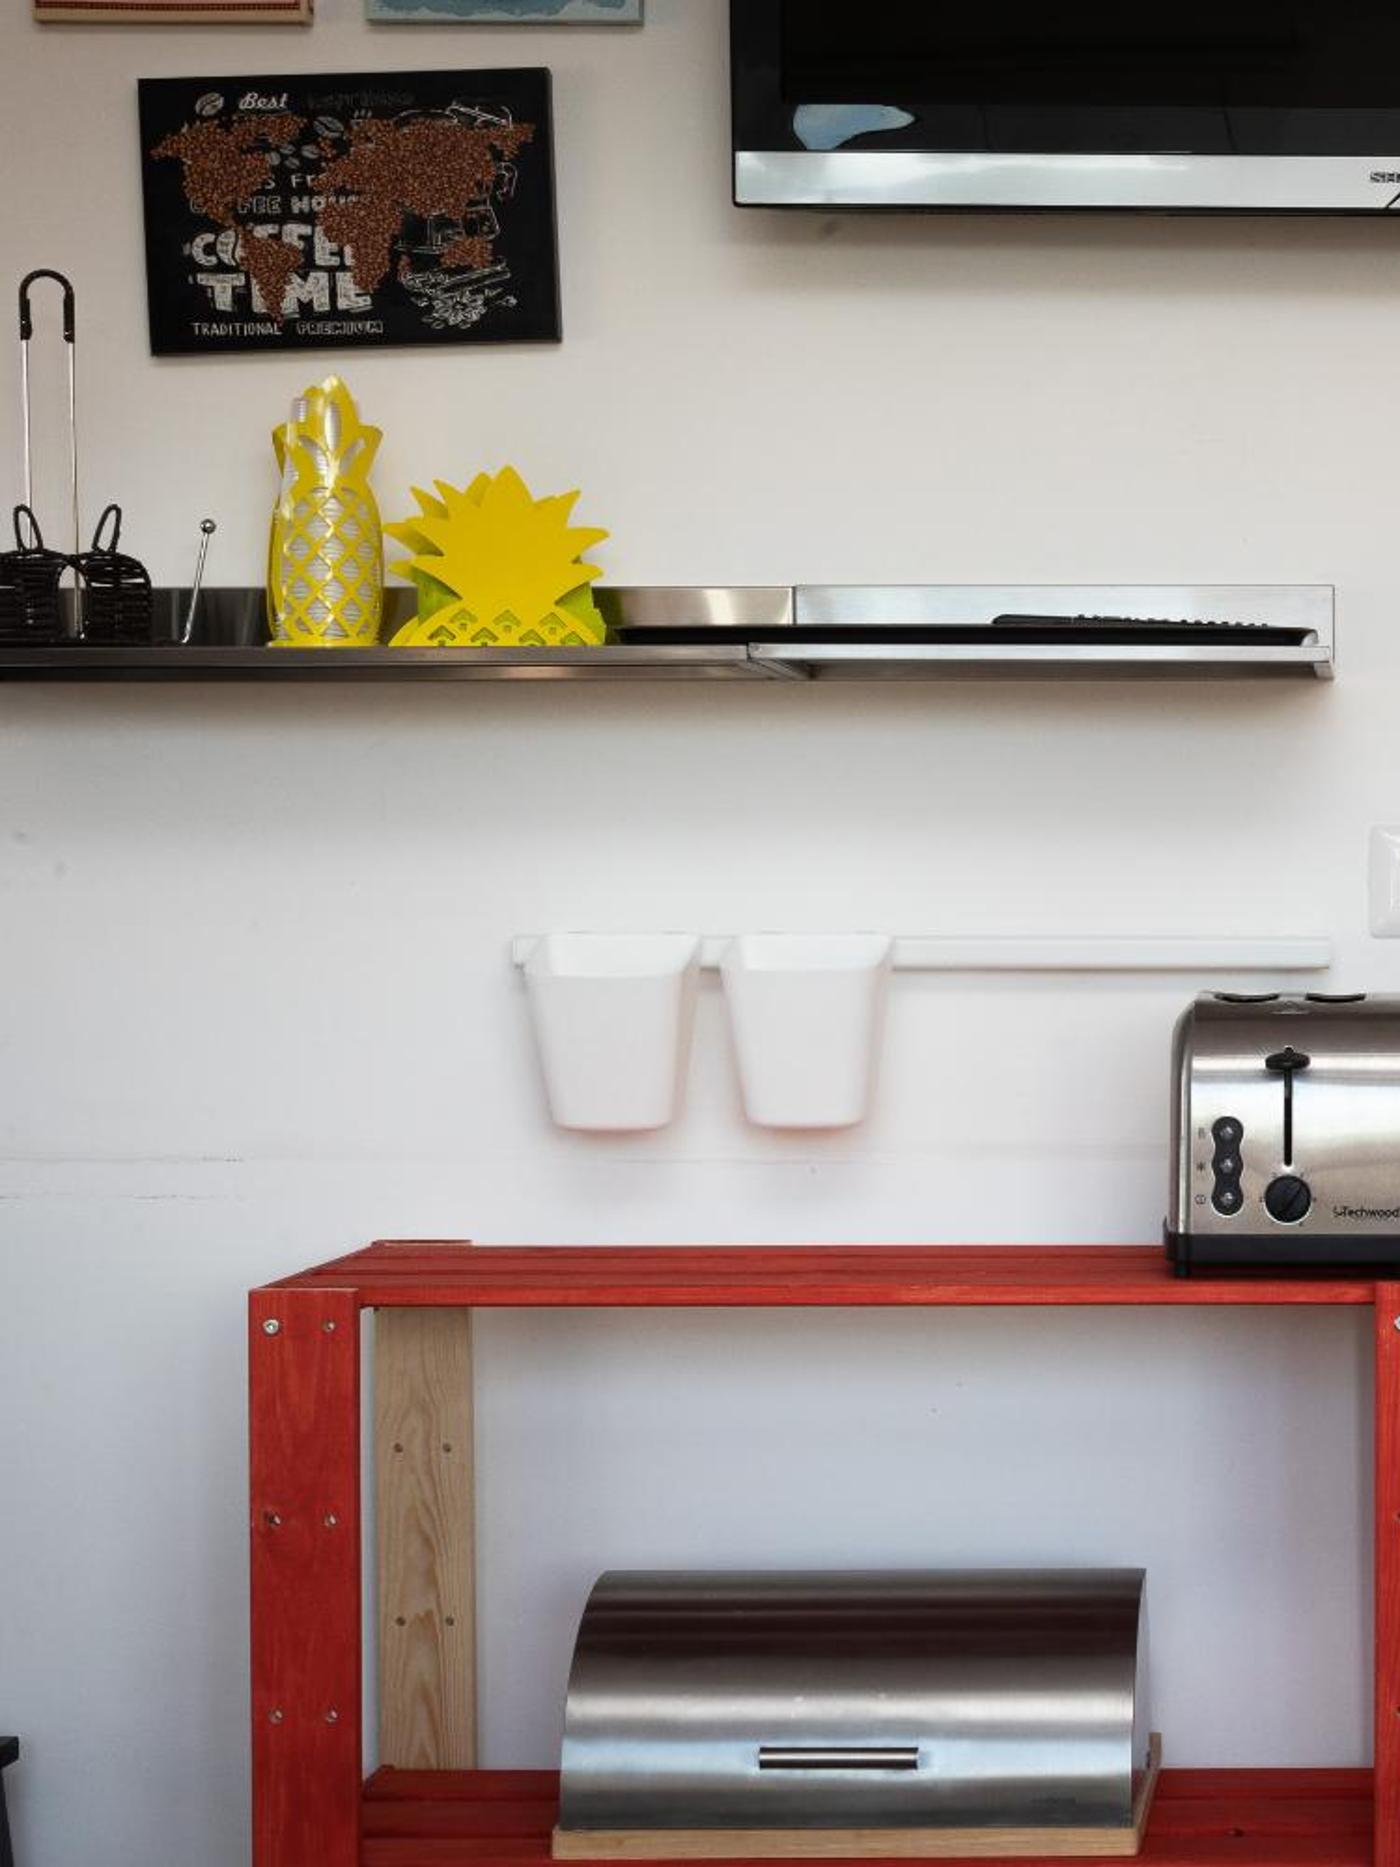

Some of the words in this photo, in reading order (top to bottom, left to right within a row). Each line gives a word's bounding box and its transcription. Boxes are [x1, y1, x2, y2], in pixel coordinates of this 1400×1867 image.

[239, 91, 288, 109] Best
[192, 321, 283, 336] TRADITIONAL
[295, 320, 384, 336] PREMIUM
